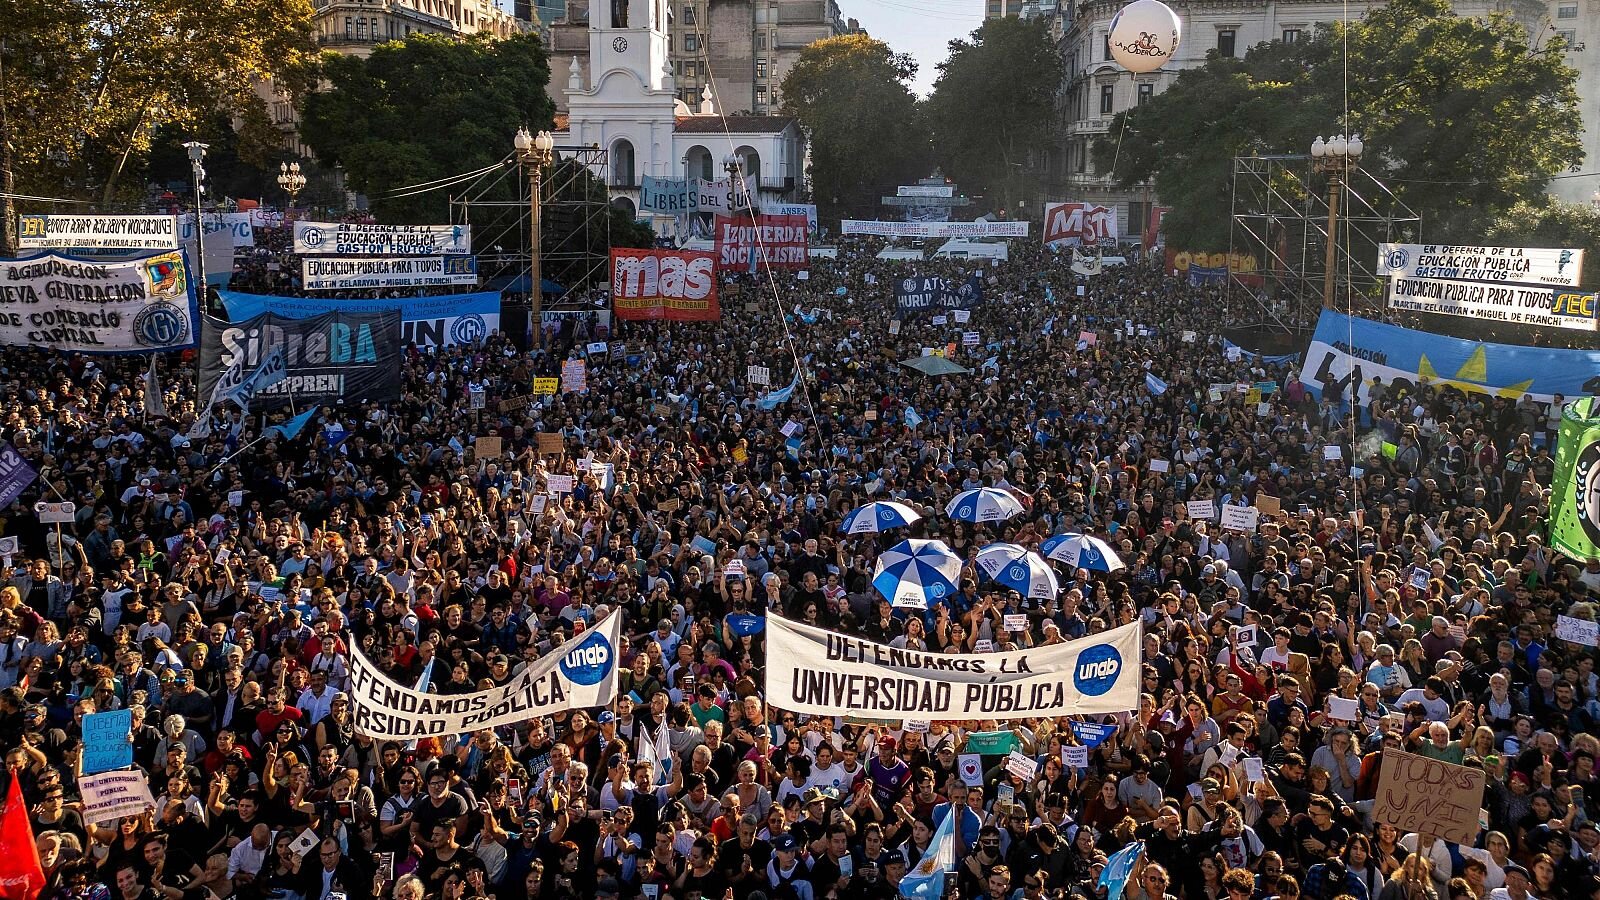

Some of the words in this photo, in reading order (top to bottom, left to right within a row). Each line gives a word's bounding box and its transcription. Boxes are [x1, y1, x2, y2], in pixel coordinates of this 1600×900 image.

[701, 196, 721, 207] DEL
[338, 224, 350, 232] EN
[404, 225, 414, 233] DE
[420, 226, 432, 234] LA
[722, 223, 805, 247] IZQUIERDA
[336, 244, 384, 254] GASTON
[1424, 246, 1436, 254] EN
[1442, 246, 1486, 255] DEFENSA
[1492, 248, 1505, 256] DE
[1510, 248, 1523, 256] LA
[391, 259, 413, 273] PARA
[415, 259, 442, 272] TODOS
[1416, 268, 1458, 278] GASTON
[1462, 269, 1508, 280] FRUTOS
[621, 256, 714, 300] mas
[1487, 287, 1514, 306] PARA
[1517, 290, 1553, 310] TODOS
[1552, 293, 1595, 316] SEC
[1510, 312, 1522, 322] DE
[565, 643, 609, 669] unab
[826, 633, 986, 674] DEFENDAMOS
[999, 655, 1033, 674] LA
[1079, 657, 1119, 681] unab
[791, 667, 950, 712] UNIVERSIDAD
[963, 675, 1064, 713] PÚBLICA
[99, 776, 138, 784] UNIVERSIDAD
[1384, 750, 1481, 791] TODXS
[1404, 780, 1435, 795] CON
[98, 800, 112, 808] HAY
[1385, 788, 1468, 824] UNI
[1376, 805, 1469, 843] PUBLICA
